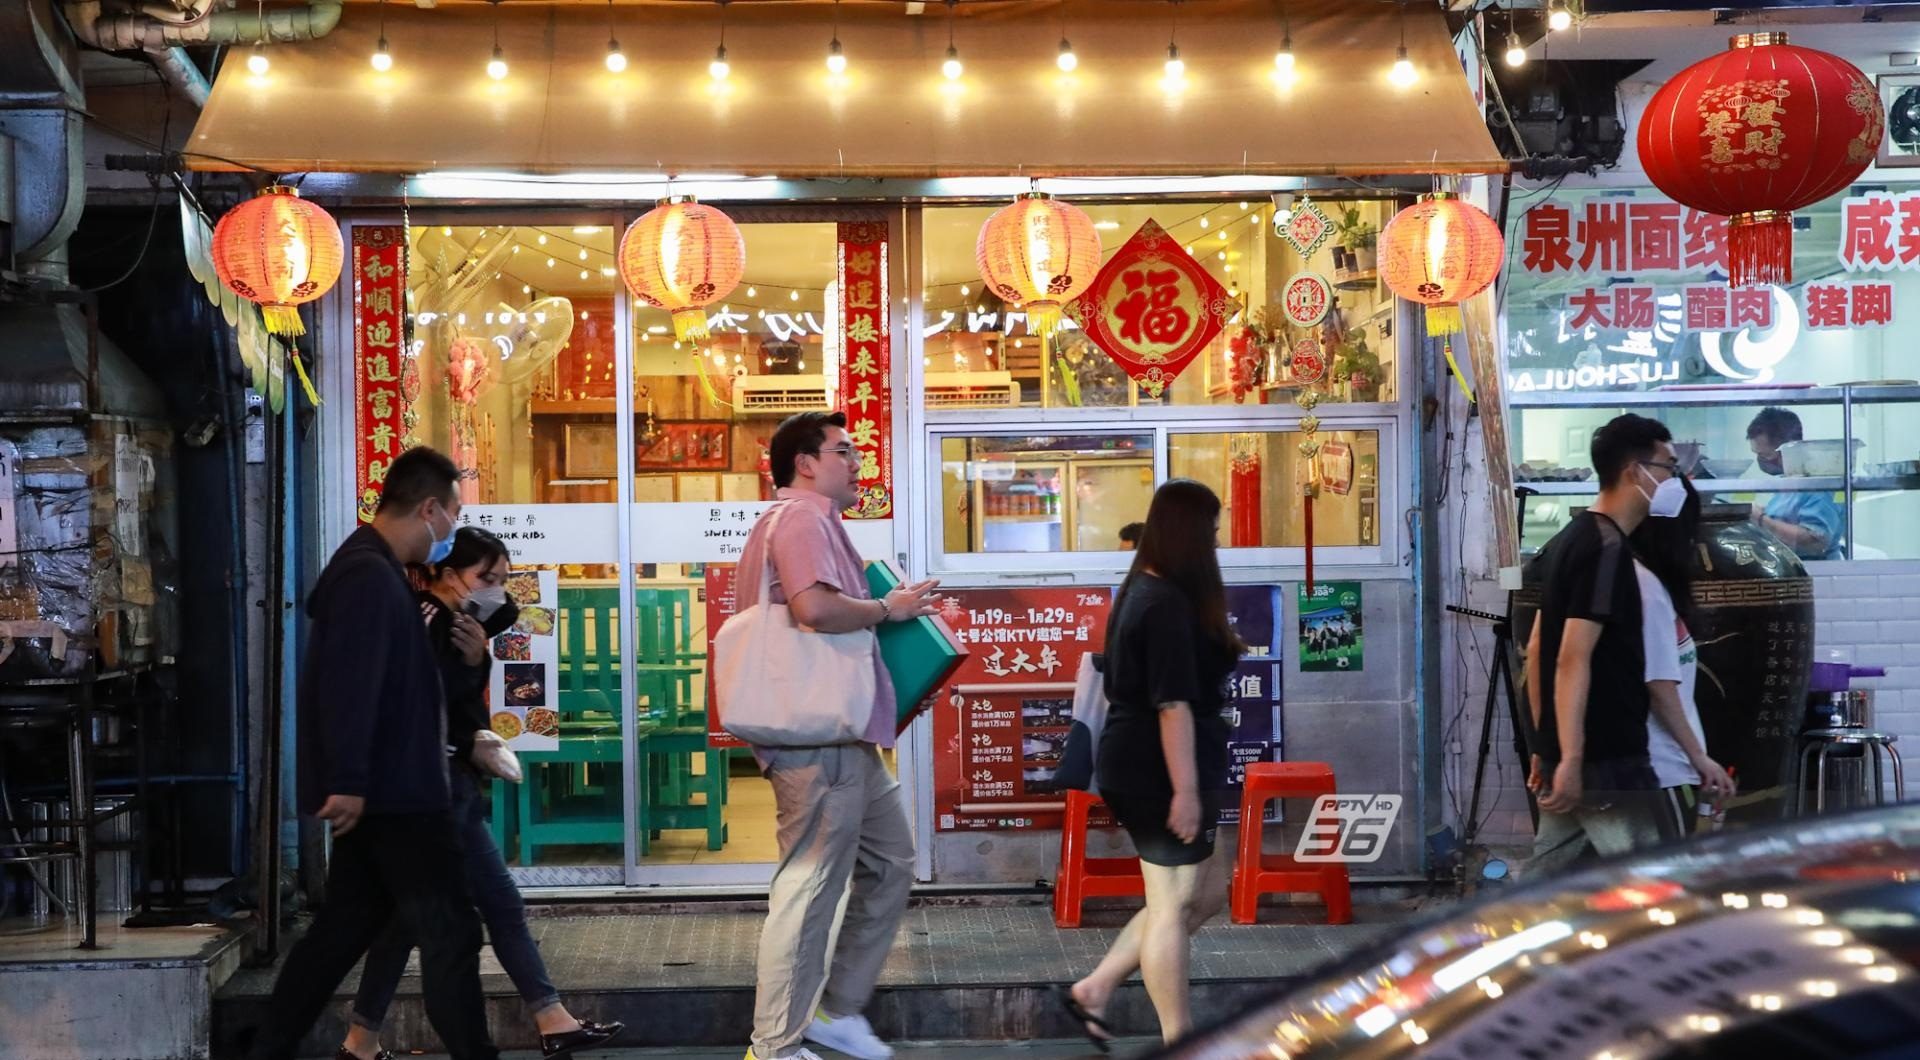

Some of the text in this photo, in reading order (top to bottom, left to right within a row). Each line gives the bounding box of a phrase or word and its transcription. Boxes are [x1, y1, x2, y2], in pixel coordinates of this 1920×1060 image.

[1113, 268, 1191, 345] 福
[1570, 287, 1655, 329] 大肠
[1686, 285, 1772, 329] 醋肉
[1807, 284, 1893, 327] 猪脚
[704, 530, 732, 538] SIWEI
[981, 644, 1063, 678] 过大年
